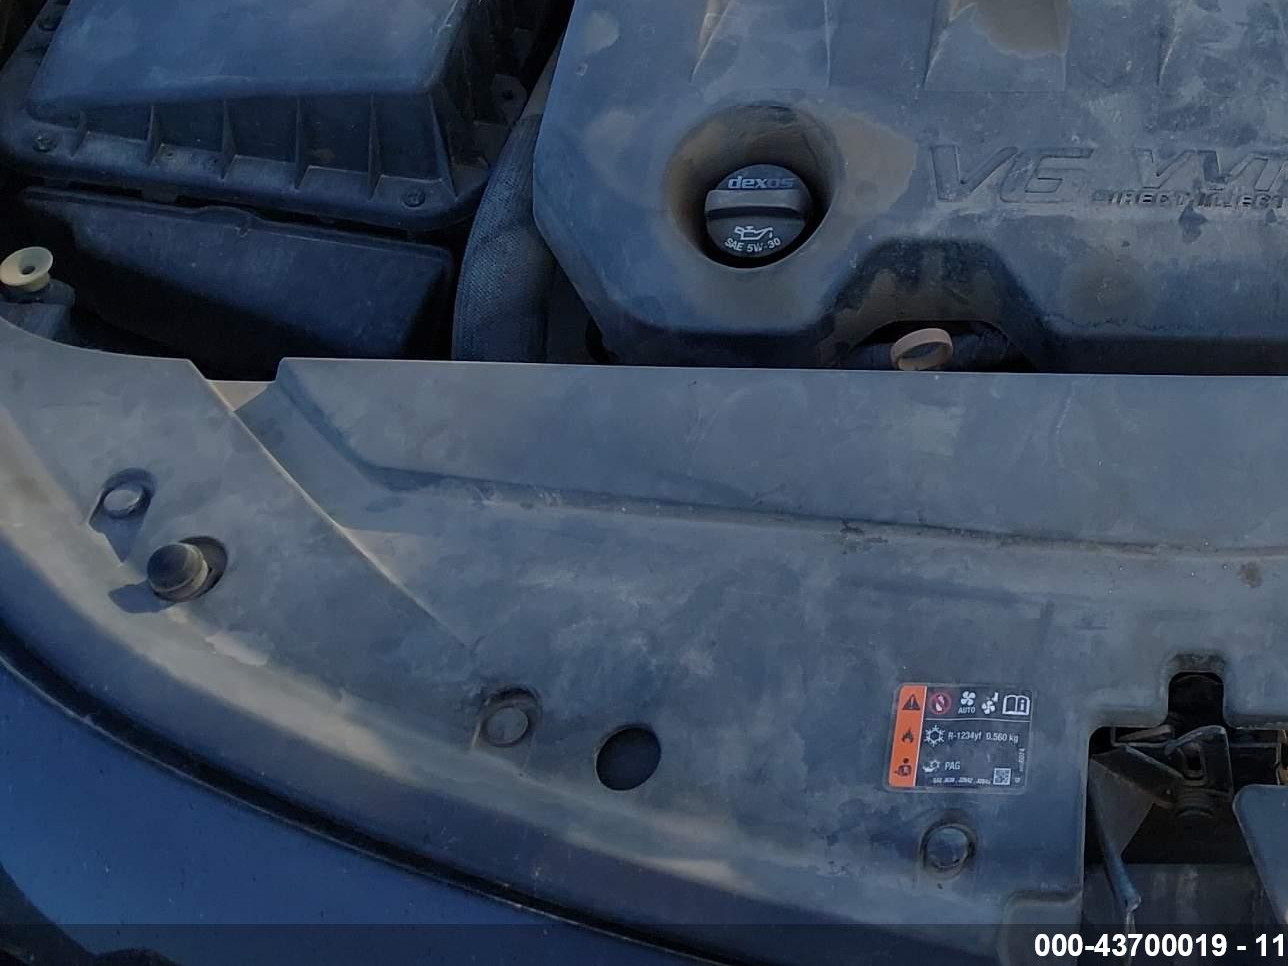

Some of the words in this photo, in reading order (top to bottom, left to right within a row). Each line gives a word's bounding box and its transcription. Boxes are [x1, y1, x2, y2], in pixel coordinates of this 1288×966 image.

[929, 144, 1095, 204] V6
[727, 175, 794, 189] dexos
[1093, 188, 1190, 207] DIRECT
[724, 237, 745, 252] SAE
[746, 237, 782, 253] 5W-30
[957, 705, 976, 715] AUTO
[947, 731, 982, 742] R-1234yf
[985, 733, 1008, 742] 0.560
[1008, 734, 1019, 744] kg
[944, 761, 961, 771] PAG
